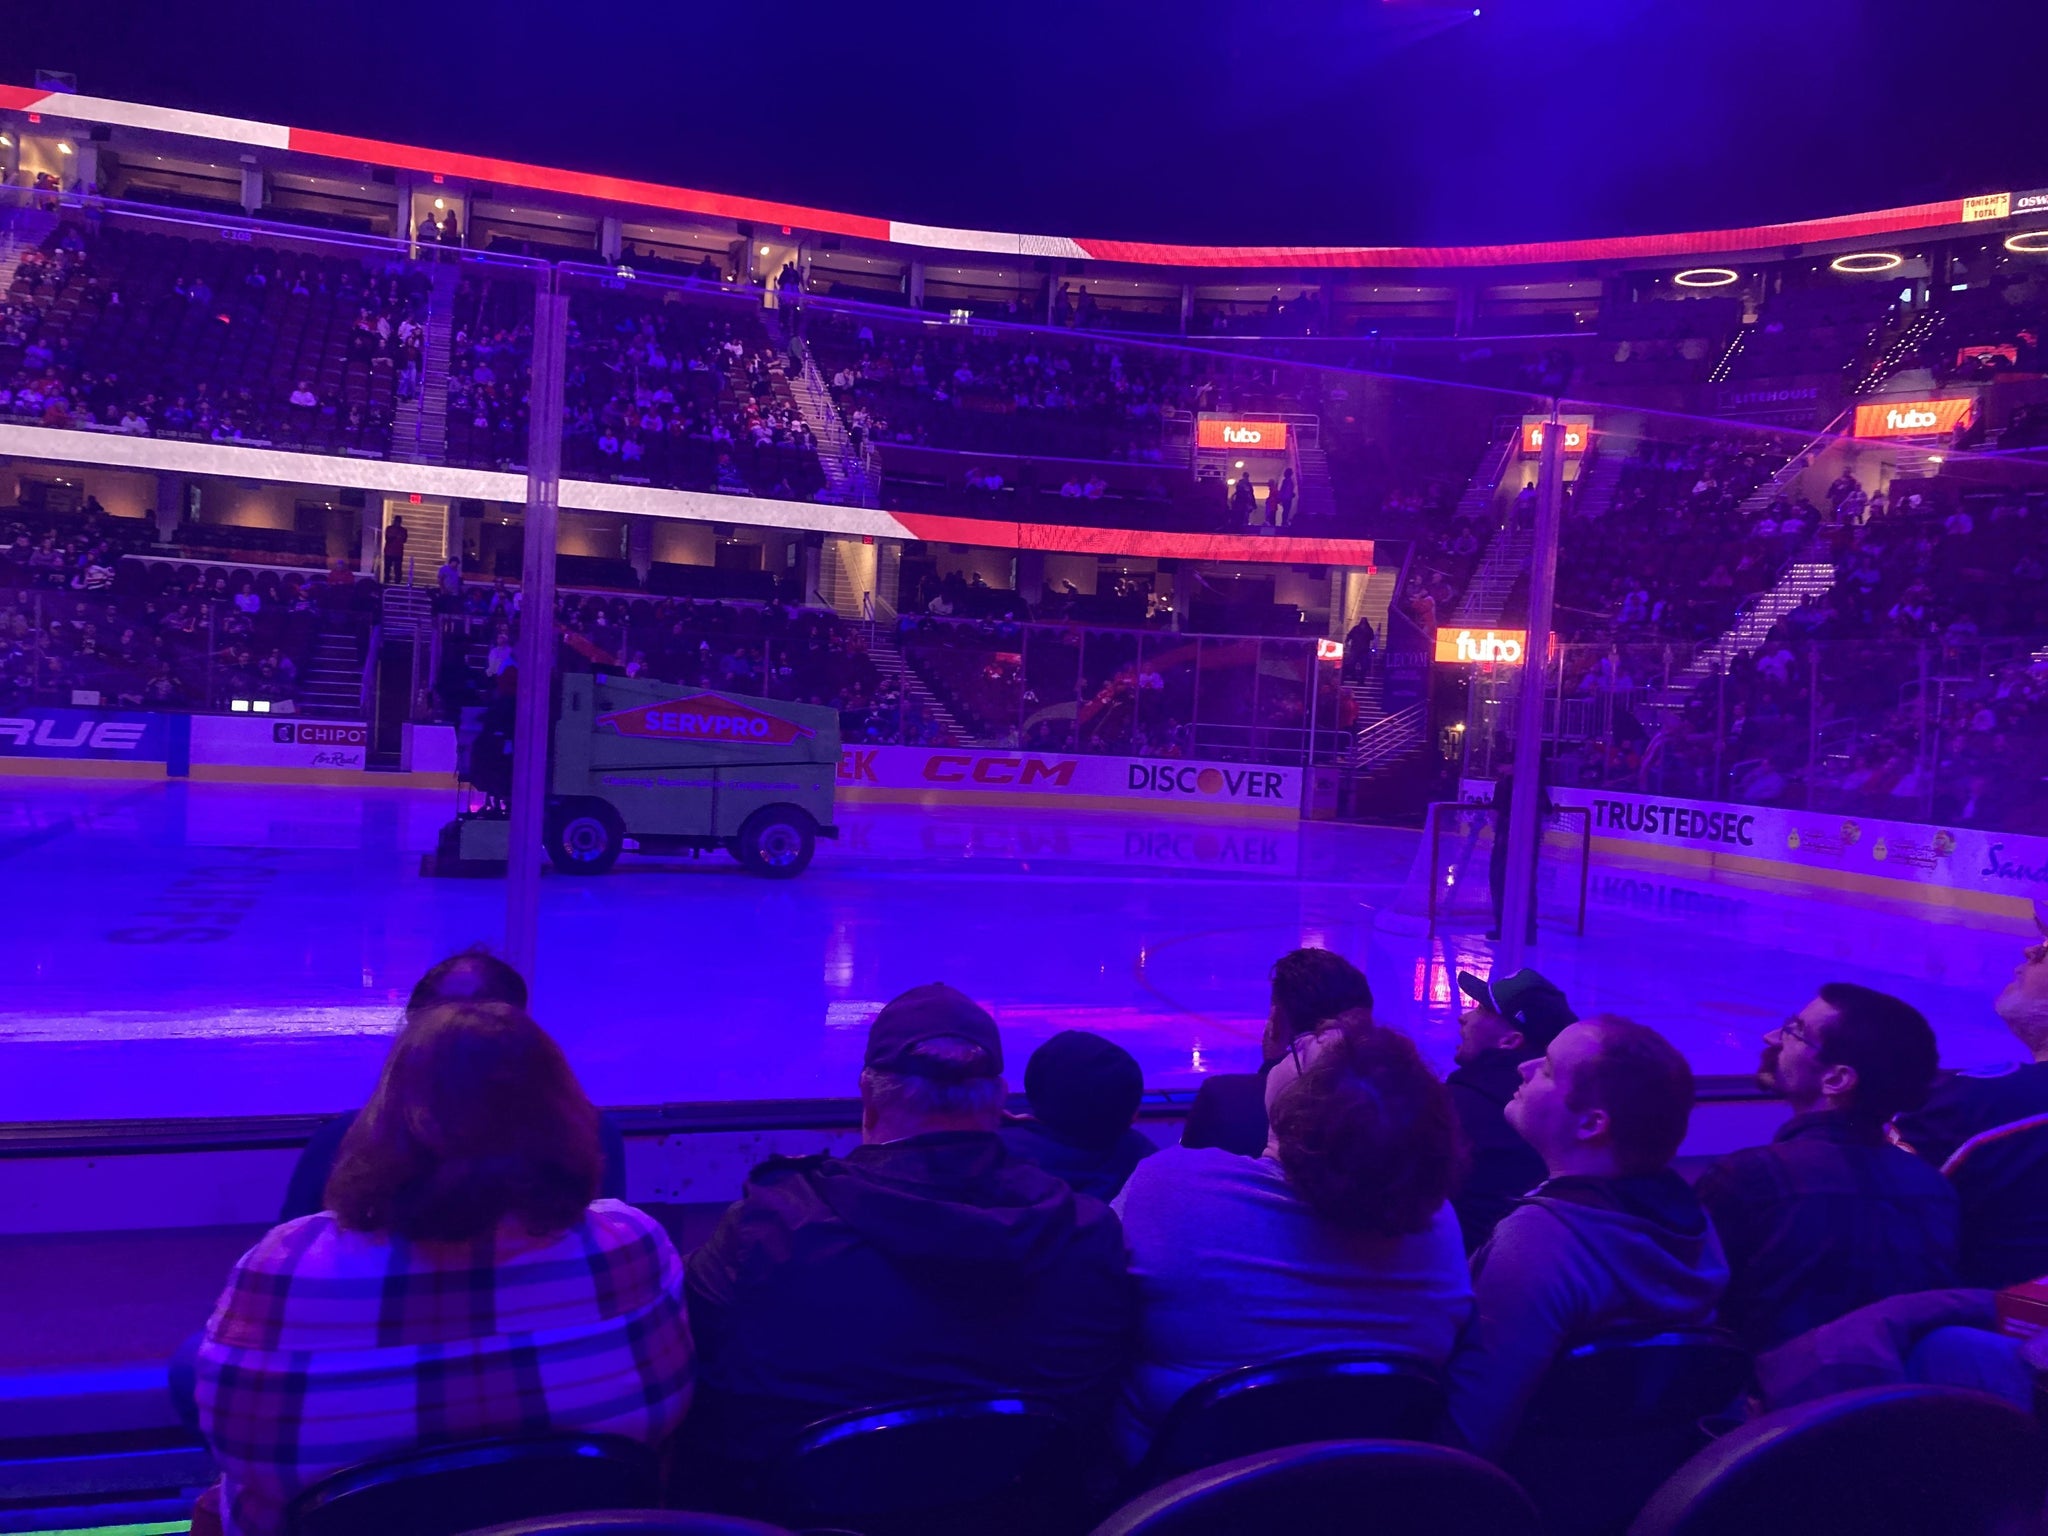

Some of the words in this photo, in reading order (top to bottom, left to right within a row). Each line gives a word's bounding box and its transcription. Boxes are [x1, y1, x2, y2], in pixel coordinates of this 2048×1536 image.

[2017, 194, 2048, 207] OSW
[1974, 208, 1997, 218] TOTAL
[1735, 387, 1818, 404] LITEHOUSE
[1886, 409, 1937, 429] fubo
[1223, 426, 1261, 443] fubo
[1531, 429, 1580, 446] fo
[1456, 631, 1522, 662] fubo
[645, 710, 769, 738] SERVPRO
[922, 755, 1079, 787] CCM
[1128, 763, 1284, 799] DISCOVER
[1593, 799, 1755, 847] TRUSTEDSEC
